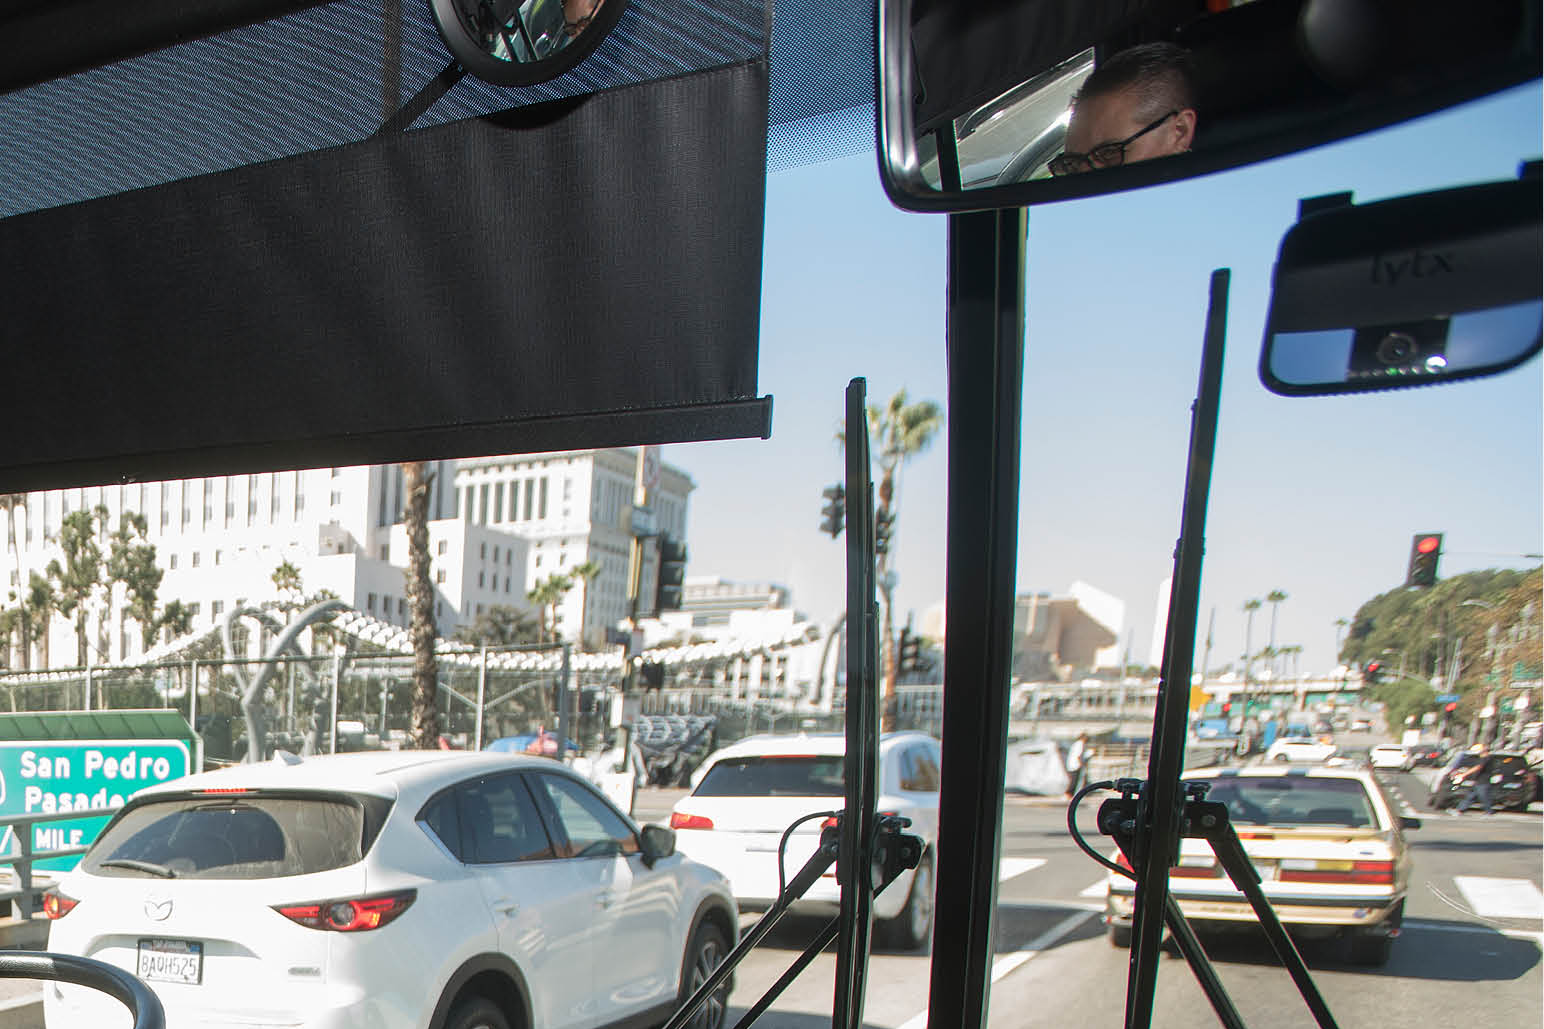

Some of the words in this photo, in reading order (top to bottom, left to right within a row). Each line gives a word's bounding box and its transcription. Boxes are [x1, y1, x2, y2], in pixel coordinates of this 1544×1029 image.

[20, 750, 71, 779] San
[84, 750, 171, 780] Pedro
[35, 828, 83, 849] MILE
